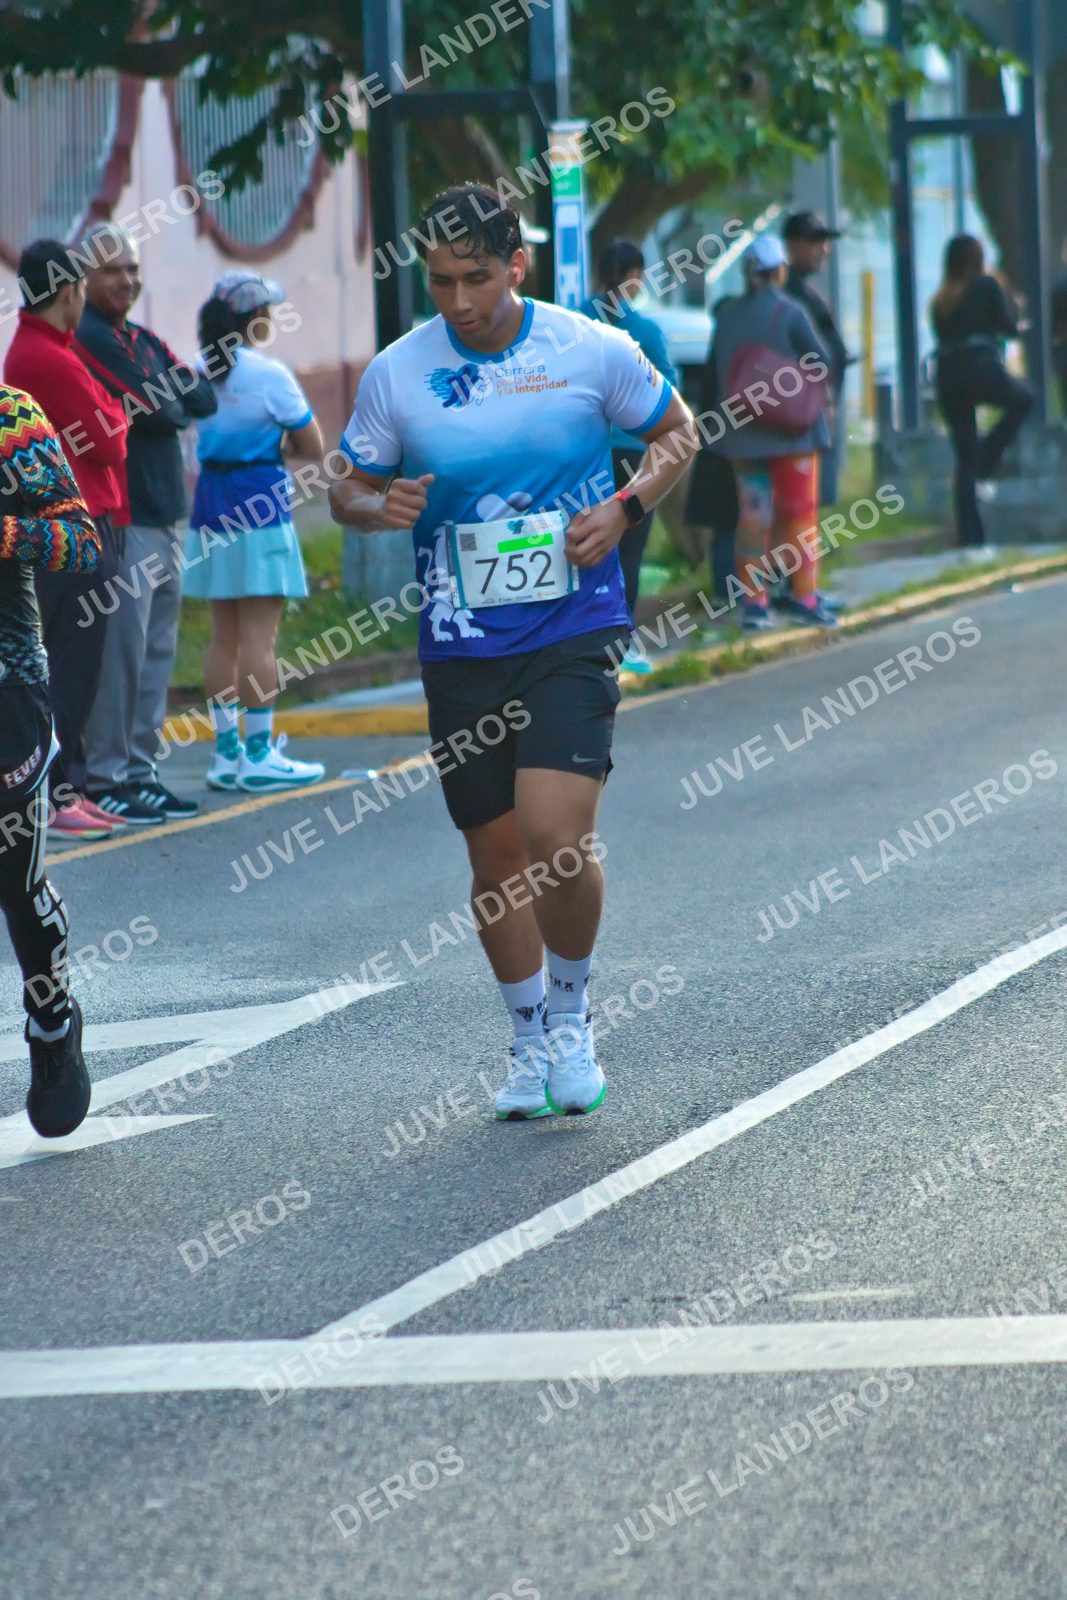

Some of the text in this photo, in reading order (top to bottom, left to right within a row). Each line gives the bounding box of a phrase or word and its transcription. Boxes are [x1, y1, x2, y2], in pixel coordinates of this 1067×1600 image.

[495, 365, 545, 378] Carrera
[525, 373, 548, 383] Vida
[516, 379, 567, 393] Integridad
[475, 550, 555, 595] 752
